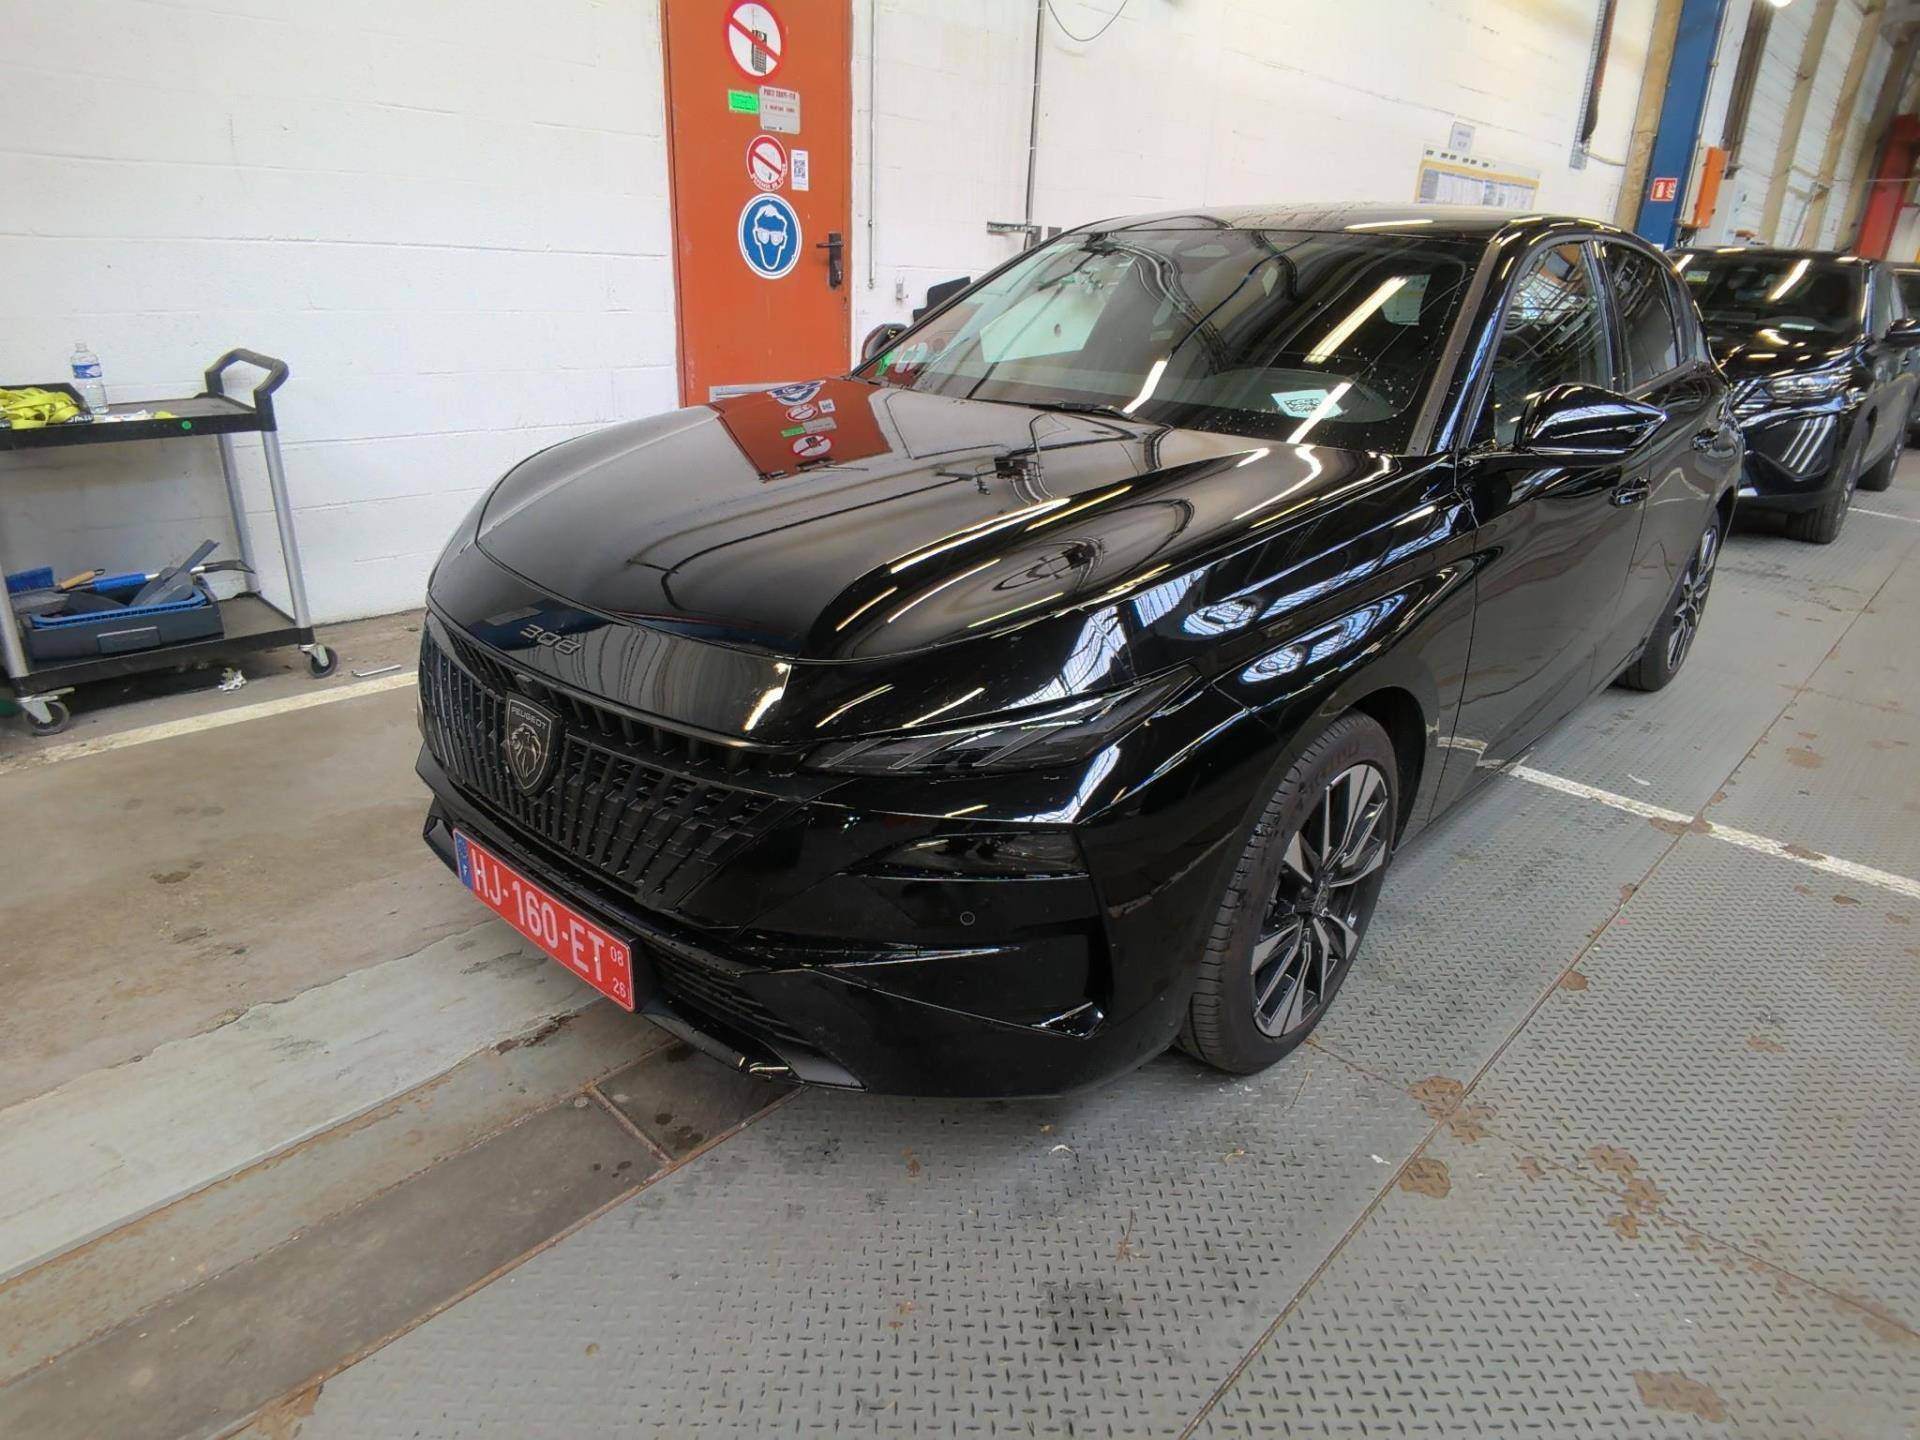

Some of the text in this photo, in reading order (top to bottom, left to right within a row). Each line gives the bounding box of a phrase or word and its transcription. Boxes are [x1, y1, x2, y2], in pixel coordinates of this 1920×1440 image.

[520, 624, 581, 654] 308
[511, 706, 546, 729] PEUGEOT
[471, 848, 605, 982] HJ-160-ET
[610, 946, 624, 966] 08
